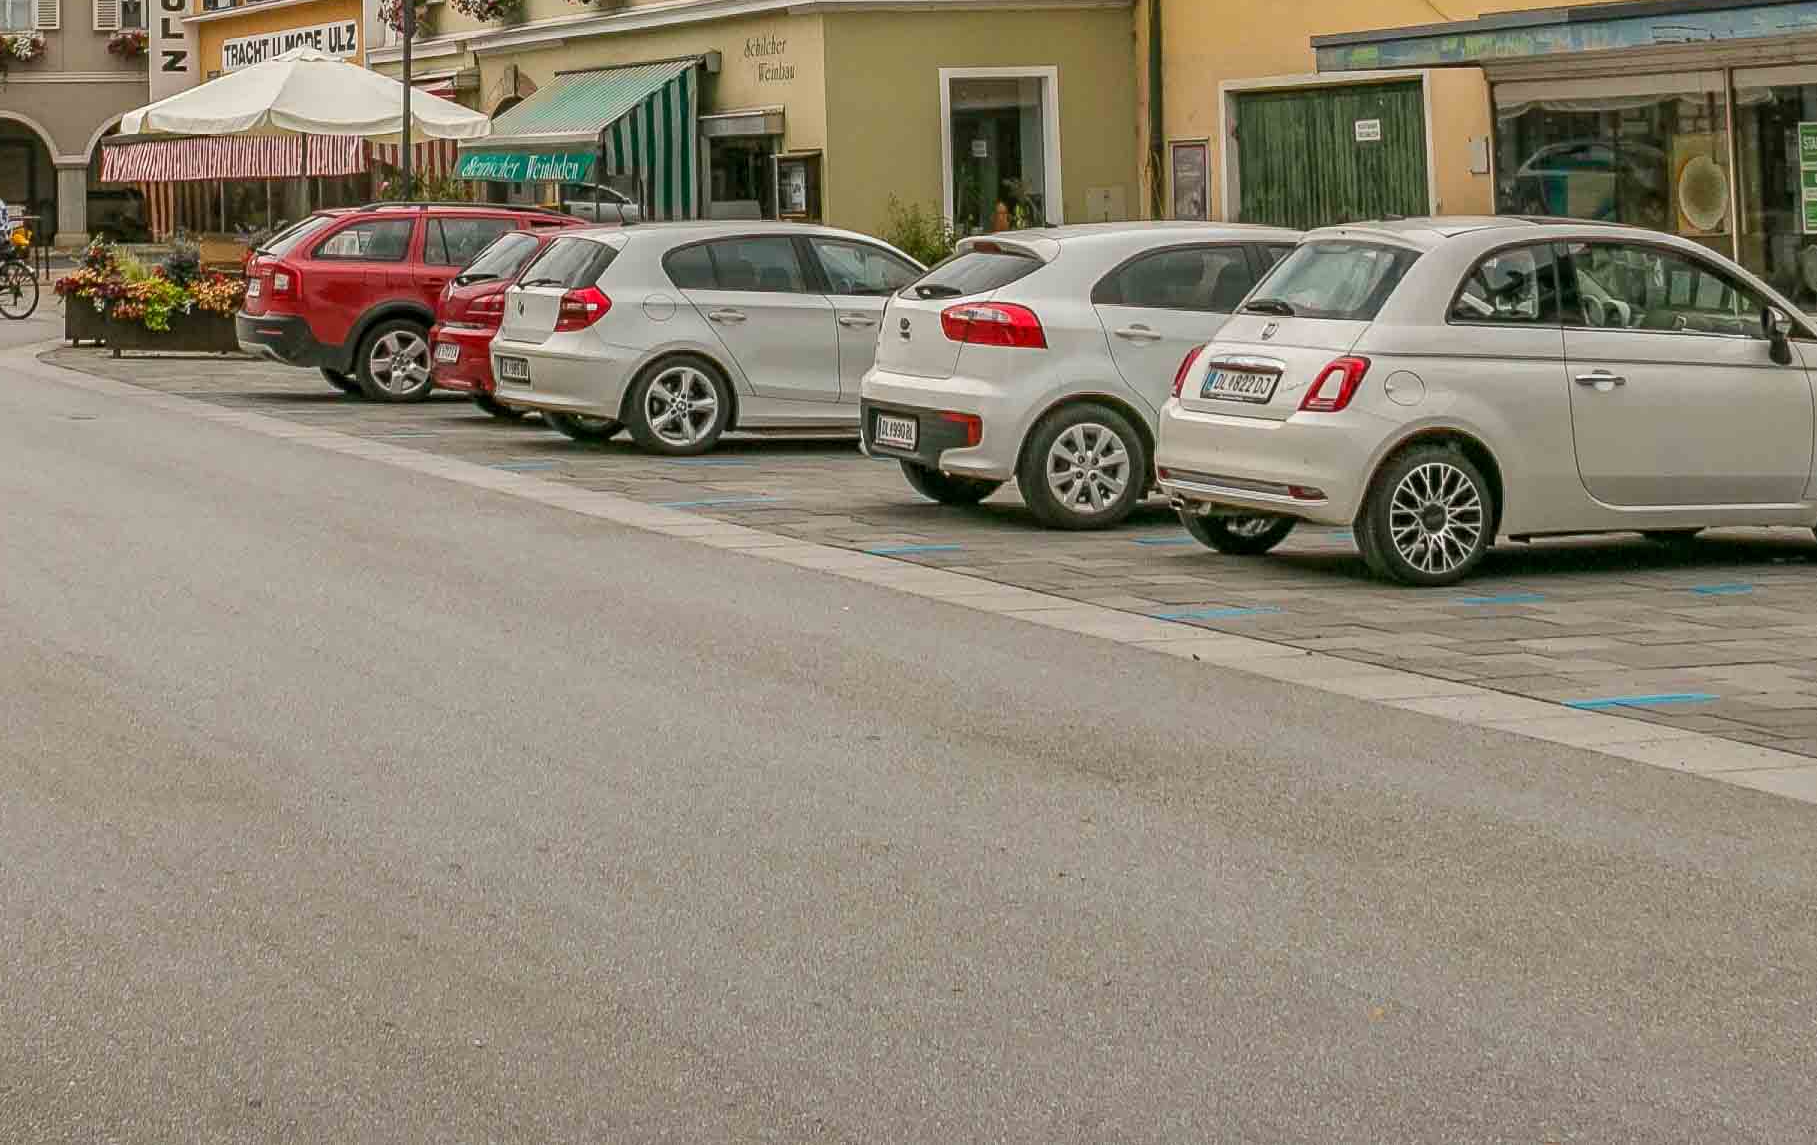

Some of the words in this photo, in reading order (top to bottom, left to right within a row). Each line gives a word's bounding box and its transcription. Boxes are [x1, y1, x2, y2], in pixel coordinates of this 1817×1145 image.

[224, 39, 269, 67] TRACHT
[328, 23, 356, 54] ULZ
[744, 34, 786, 58] Schilcher
[758, 61, 796, 82] Weinbau
